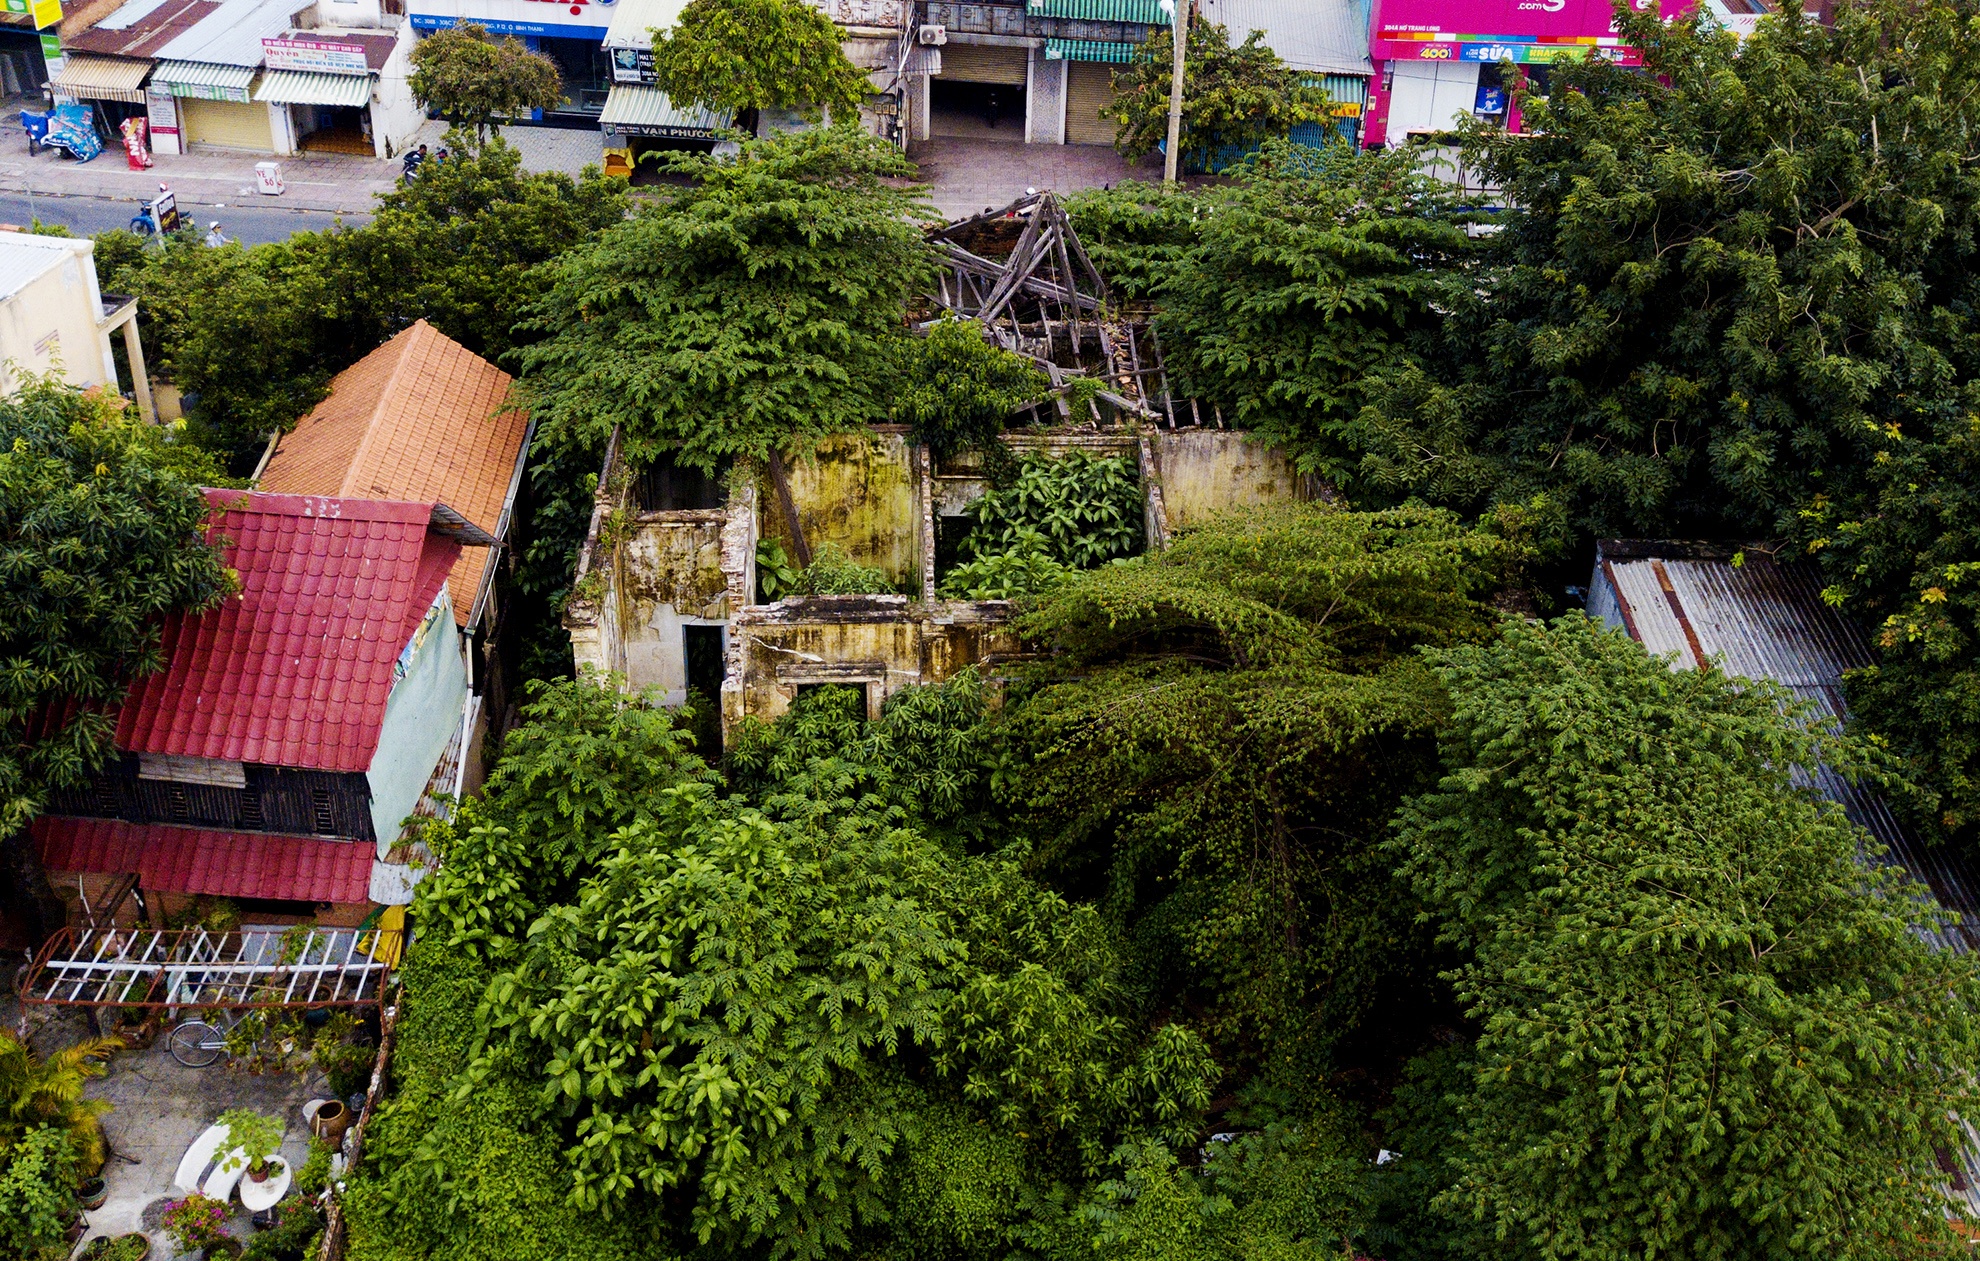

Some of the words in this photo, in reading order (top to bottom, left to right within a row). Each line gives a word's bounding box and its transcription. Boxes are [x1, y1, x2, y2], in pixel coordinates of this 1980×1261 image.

[1420, 48, 1449, 59] 400
[1478, 45, 1514, 61] SỮA
[641, 127, 668, 137] VẠN
[670, 129, 715, 139] PHƯỚC
